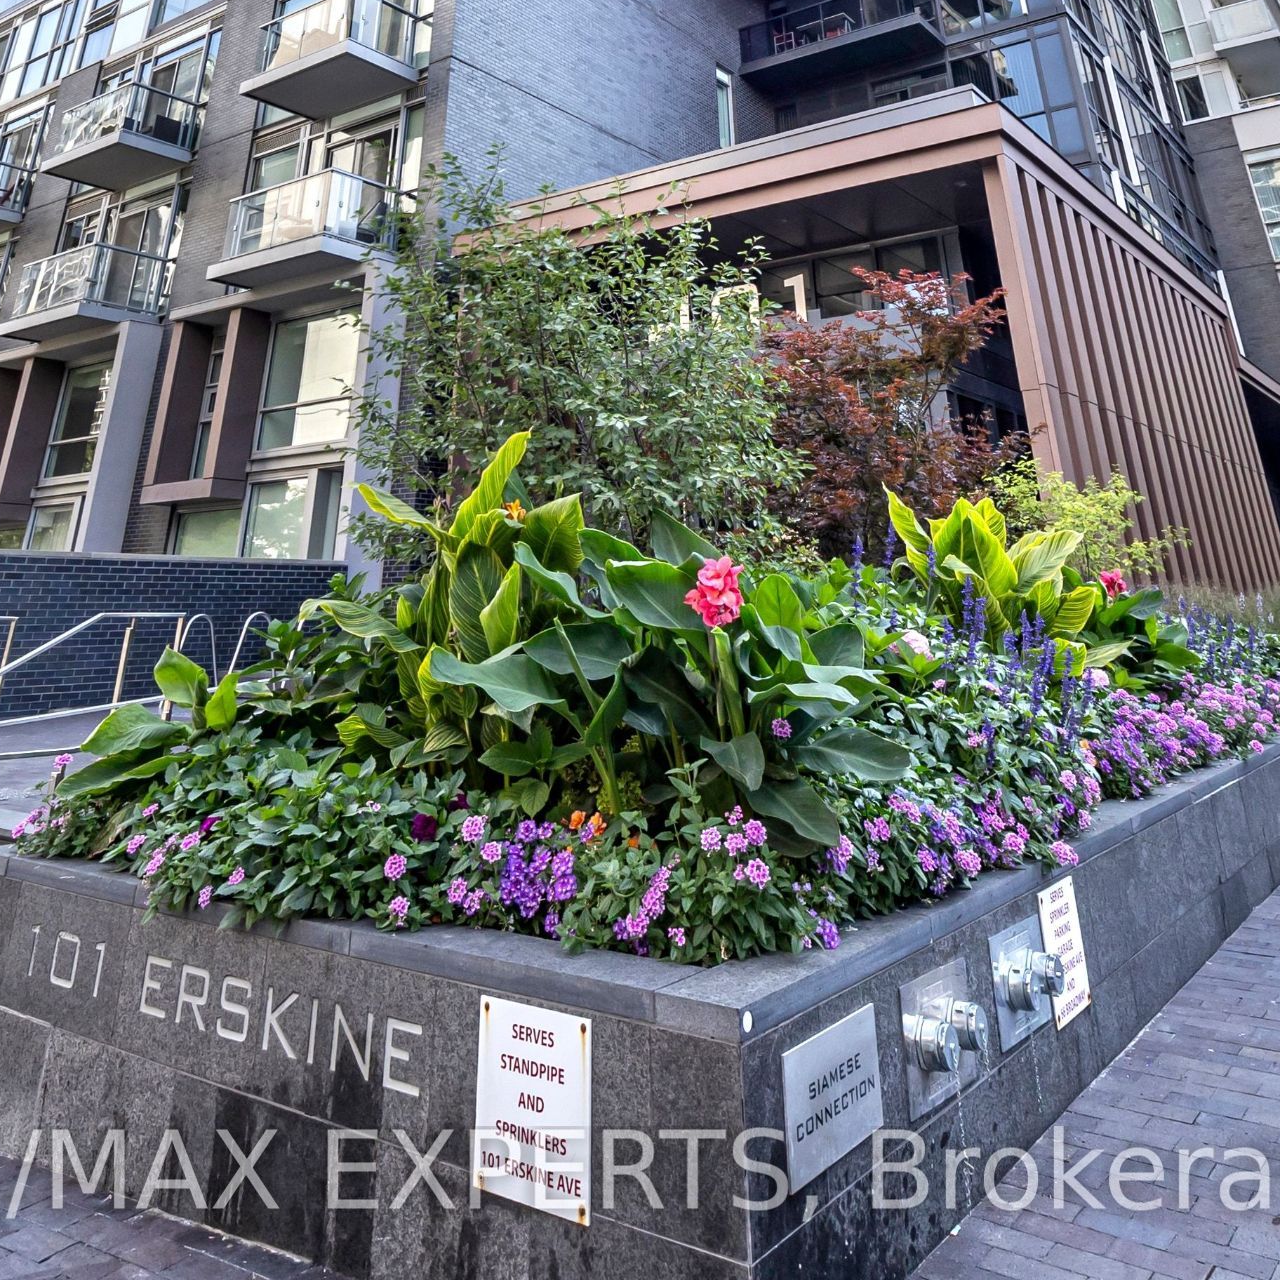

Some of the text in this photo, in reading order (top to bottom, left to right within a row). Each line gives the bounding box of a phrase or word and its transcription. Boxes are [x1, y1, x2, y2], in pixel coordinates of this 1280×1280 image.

[1054, 920, 1071, 941] PARKING
[1066, 977, 1076, 993] AND
[26, 923, 423, 1098] 101 ERSKINE
[511, 1023, 555, 1048] SERVES
[500, 1053, 565, 1085] STANDPIPE
[808, 1052, 861, 1100] SIAMESE
[518, 1092, 545, 1113] AND
[796, 1074, 876, 1143] CONNECTION
[495, 1119, 567, 1156] SPRINKLERS
[481, 1150, 582, 1197] 101 ERSKINE AVE
